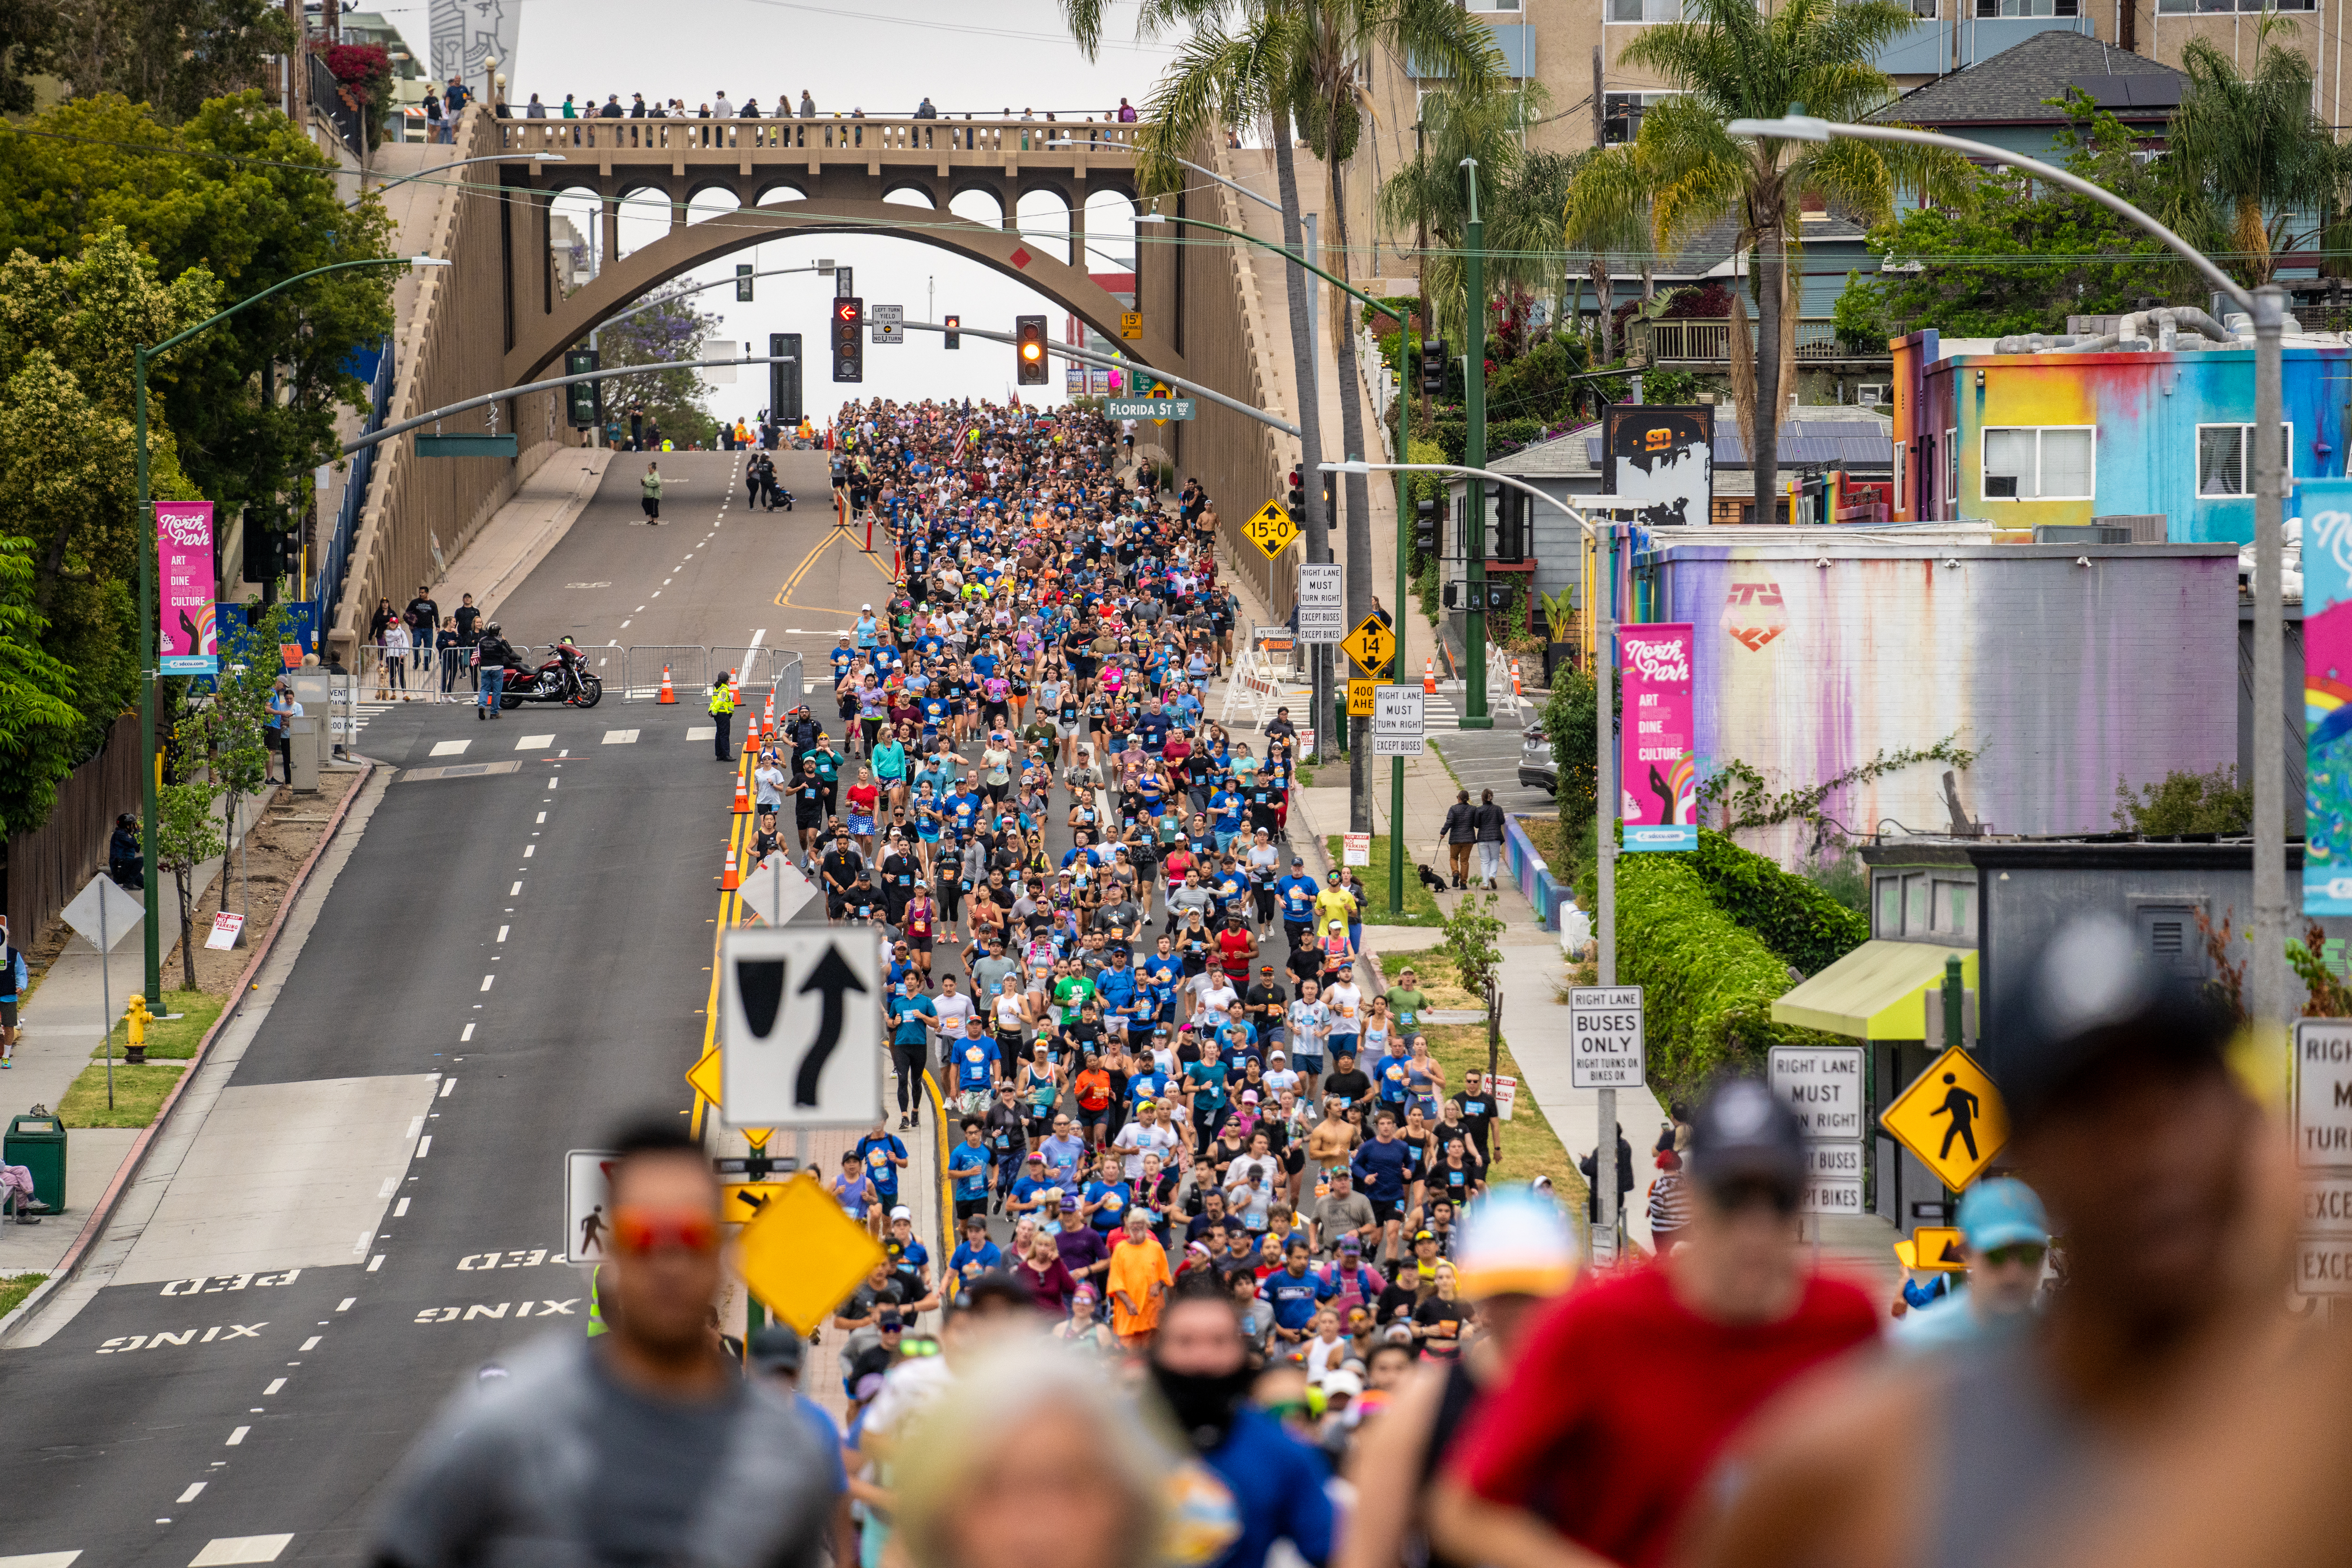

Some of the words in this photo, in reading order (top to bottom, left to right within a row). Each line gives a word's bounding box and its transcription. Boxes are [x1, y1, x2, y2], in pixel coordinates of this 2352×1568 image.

[1110, 403, 1155, 415] FLORIDA
[160, 514, 207, 532] North
[174, 528, 210, 546] Park
[171, 556, 186, 565] ART
[171, 565, 196, 575] MUSIC
[171, 576, 190, 586] DINE
[1310, 581, 1332, 589] MUST
[171, 586, 206, 596] CRAFTED
[171, 597, 206, 606] CULTURE
[1625, 640, 1685, 661] North
[1643, 658, 1690, 682] Park
[1353, 686, 1373, 696] 400
[1353, 699, 1374, 708] AHE
[1639, 694, 1659, 706] ART
[1386, 705, 1412, 715] MUST
[1639, 707, 1671, 720] MUSIC
[1638, 721, 1663, 733] DINE
[1377, 741, 1399, 750] EXCEPT
[1401, 741, 1421, 750] BUSES
[1638, 733, 1684, 747] CRAFTED
[1638, 747, 1683, 761] CULTURE
[1576, 994, 1606, 1005] RIGHT
[1610, 994, 1637, 1004] LANE
[1577, 1015, 1636, 1031] BUSES
[1582, 1036, 1631, 1052] ONLY
[2305, 1038, 2352, 1062] RIGH
[1577, 1059, 1599, 1068] RIGHT
[1601, 1058, 1626, 1068] TURNS
[1628, 1058, 1639, 1067] OK
[1776, 1059, 1815, 1073] RIGHT
[1822, 1059, 1857, 1074] LANE
[1590, 1070, 1613, 1081] BIKES
[1614, 1070, 1626, 1080] OK
[1486, 1089, 1513, 1098] PAKING
[1791, 1085, 1842, 1102] MUST
[1817, 1113, 1857, 1128] RIGHT
[2305, 1126, 2352, 1151] TUR
[1820, 1152, 1857, 1169] BUSES
[1822, 1189, 1858, 1206] BIKES
[2305, 1190, 2352, 1220] EXCE
[2304, 1251, 2352, 1280] EXCE
[160, 1269, 302, 1296] PED
[414, 1298, 582, 1323] XING
[96, 1322, 270, 1353] XING
